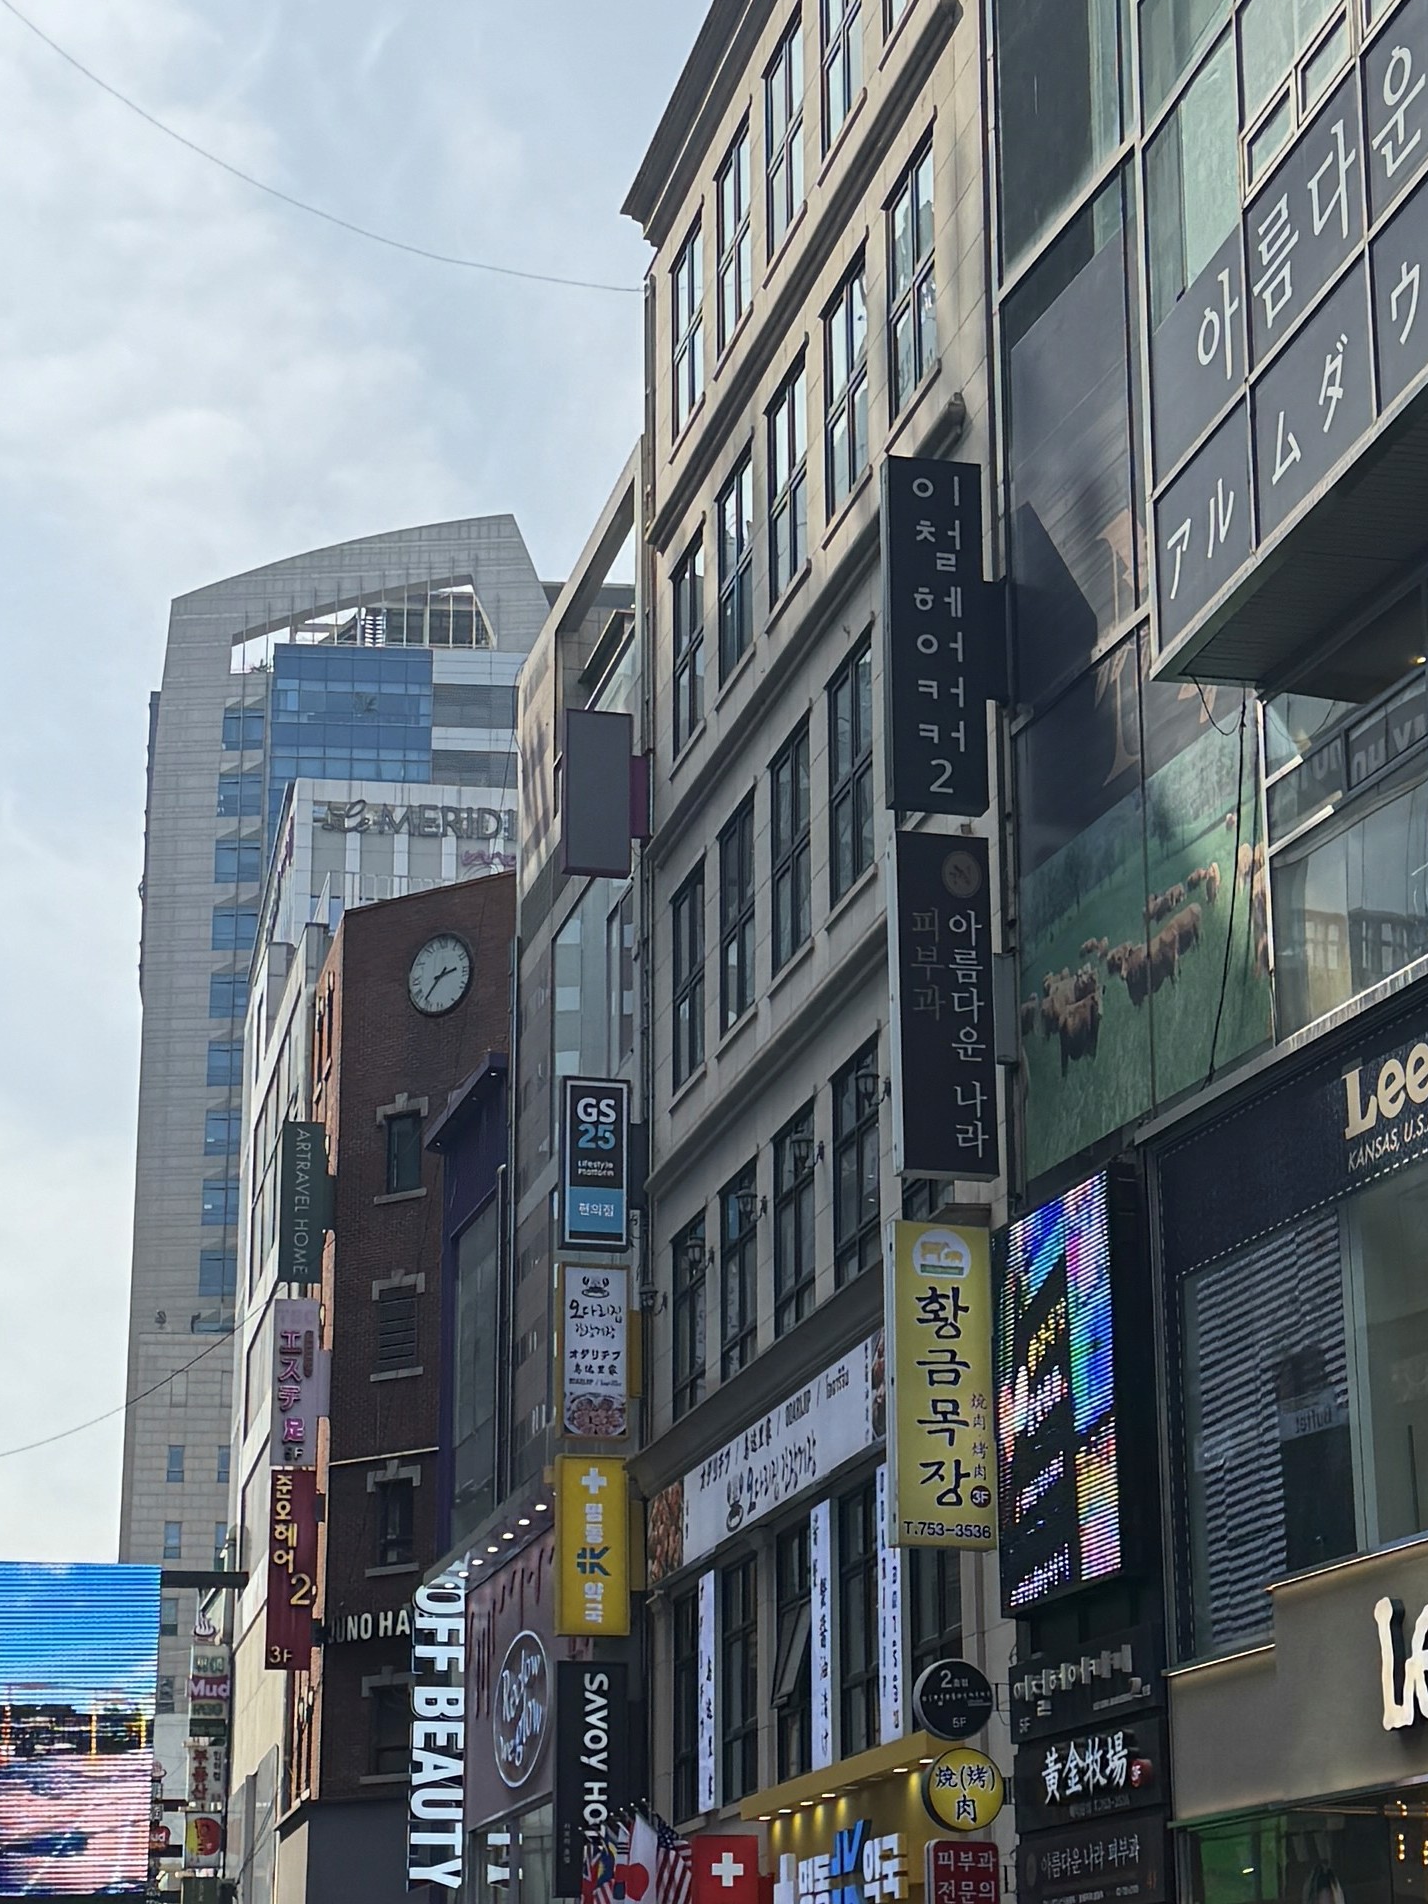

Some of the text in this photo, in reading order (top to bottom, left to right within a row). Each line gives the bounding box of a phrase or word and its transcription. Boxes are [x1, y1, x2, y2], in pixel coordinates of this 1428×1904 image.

[910, 907, 946, 1021] 피부과
[576, 1097, 617, 1124] GS
[954, 1080, 989, 1159] 나라
[577, 1123, 616, 1150] 25
[1347, 1127, 1400, 1173] KANSAS,
[577, 1159, 614, 1170] Lifestyle
[577, 1168, 615, 1177] Platform
[292, 1127, 311, 1276] ARTRAVEL HOME
[578, 1203, 615, 1217] 편의점
[914, 1286, 972, 1508] 황금목장
[972, 1489, 990, 1504] 3F
[273, 1475, 312, 1606] 준오헤어 2
[903, 1520, 992, 1540] T.753-3536
[327, 1612, 373, 1644] JUNO
[269, 1645, 294, 1664] 3F
[189, 1678, 231, 1698] Mud
[580, 1672, 609, 1773] SAVOY
[410, 1686, 466, 1889] BEAUTY
[956, 1794, 978, 1824] 肉
[937, 1850, 997, 1873] 피부과
[1108, 1833, 1141, 1867] 피부과
